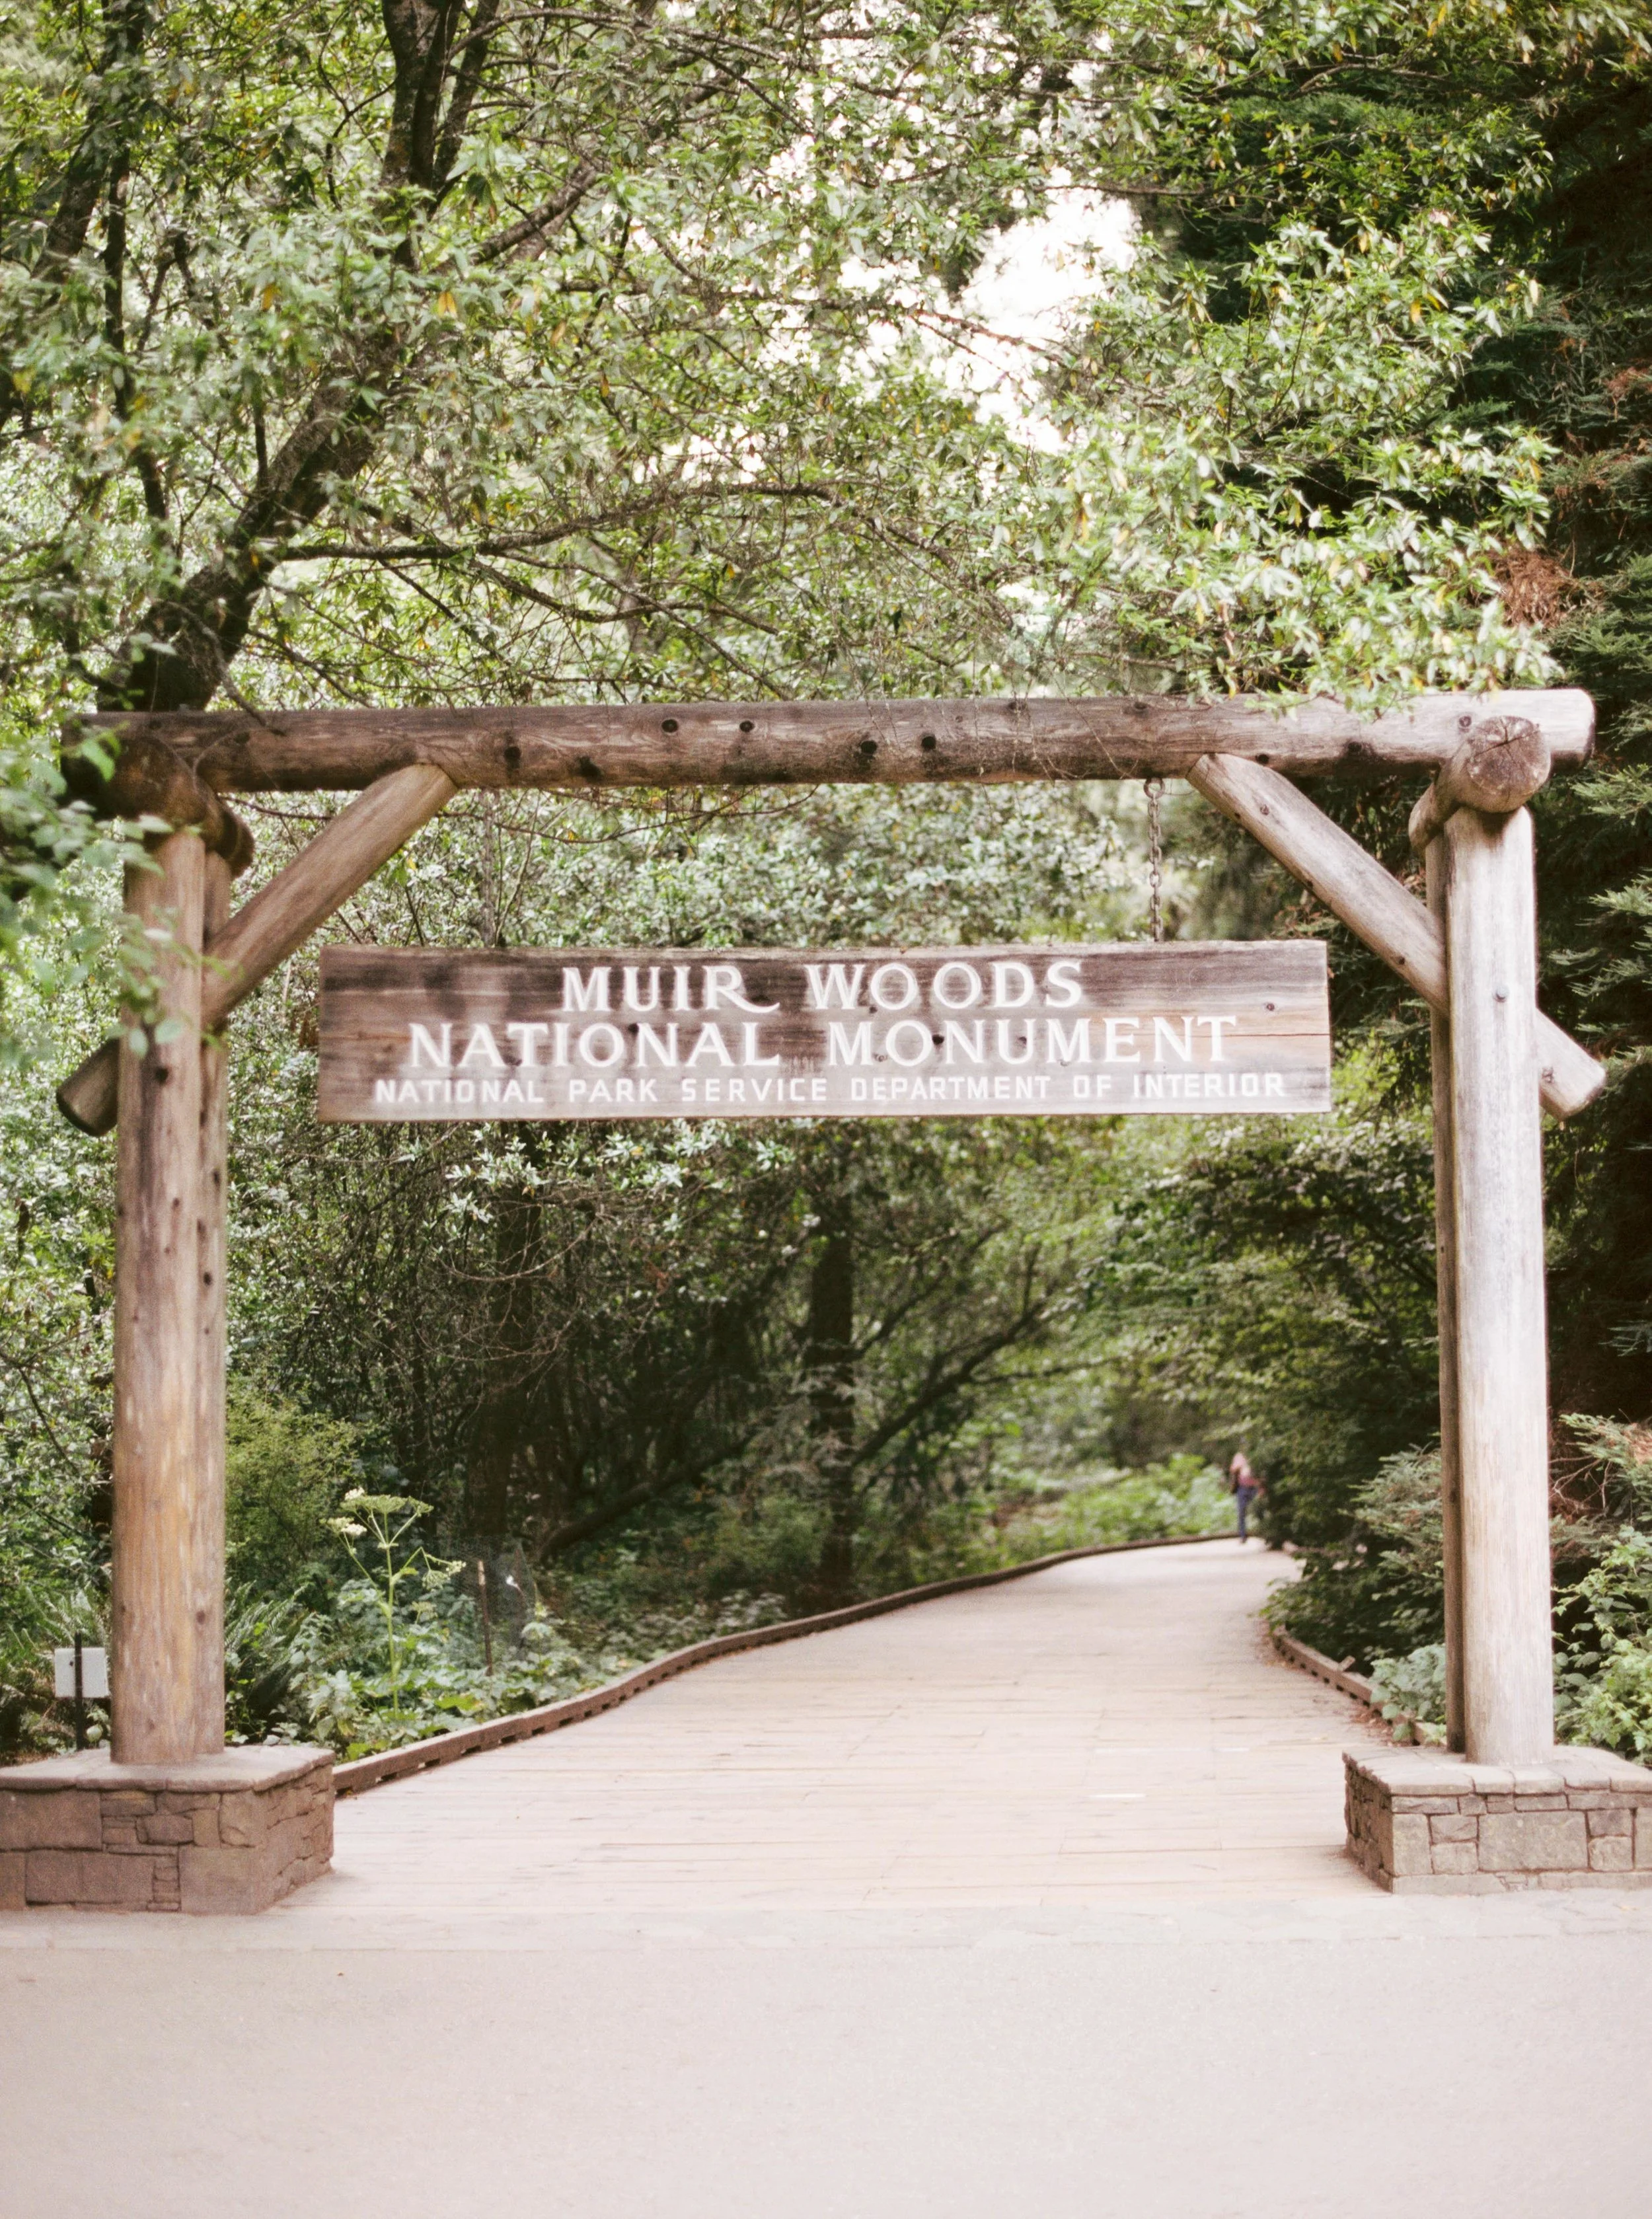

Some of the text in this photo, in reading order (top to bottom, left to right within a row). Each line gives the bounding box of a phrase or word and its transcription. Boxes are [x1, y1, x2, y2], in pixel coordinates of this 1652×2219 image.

[563, 961, 1082, 1013] MUIR WOODS
[408, 1016, 1237, 1068] NATIONAL MONUMENT
[375, 1072, 1285, 1103] NATIONAL PARK SERVICE DEPARTMENT OF INTERIOR
